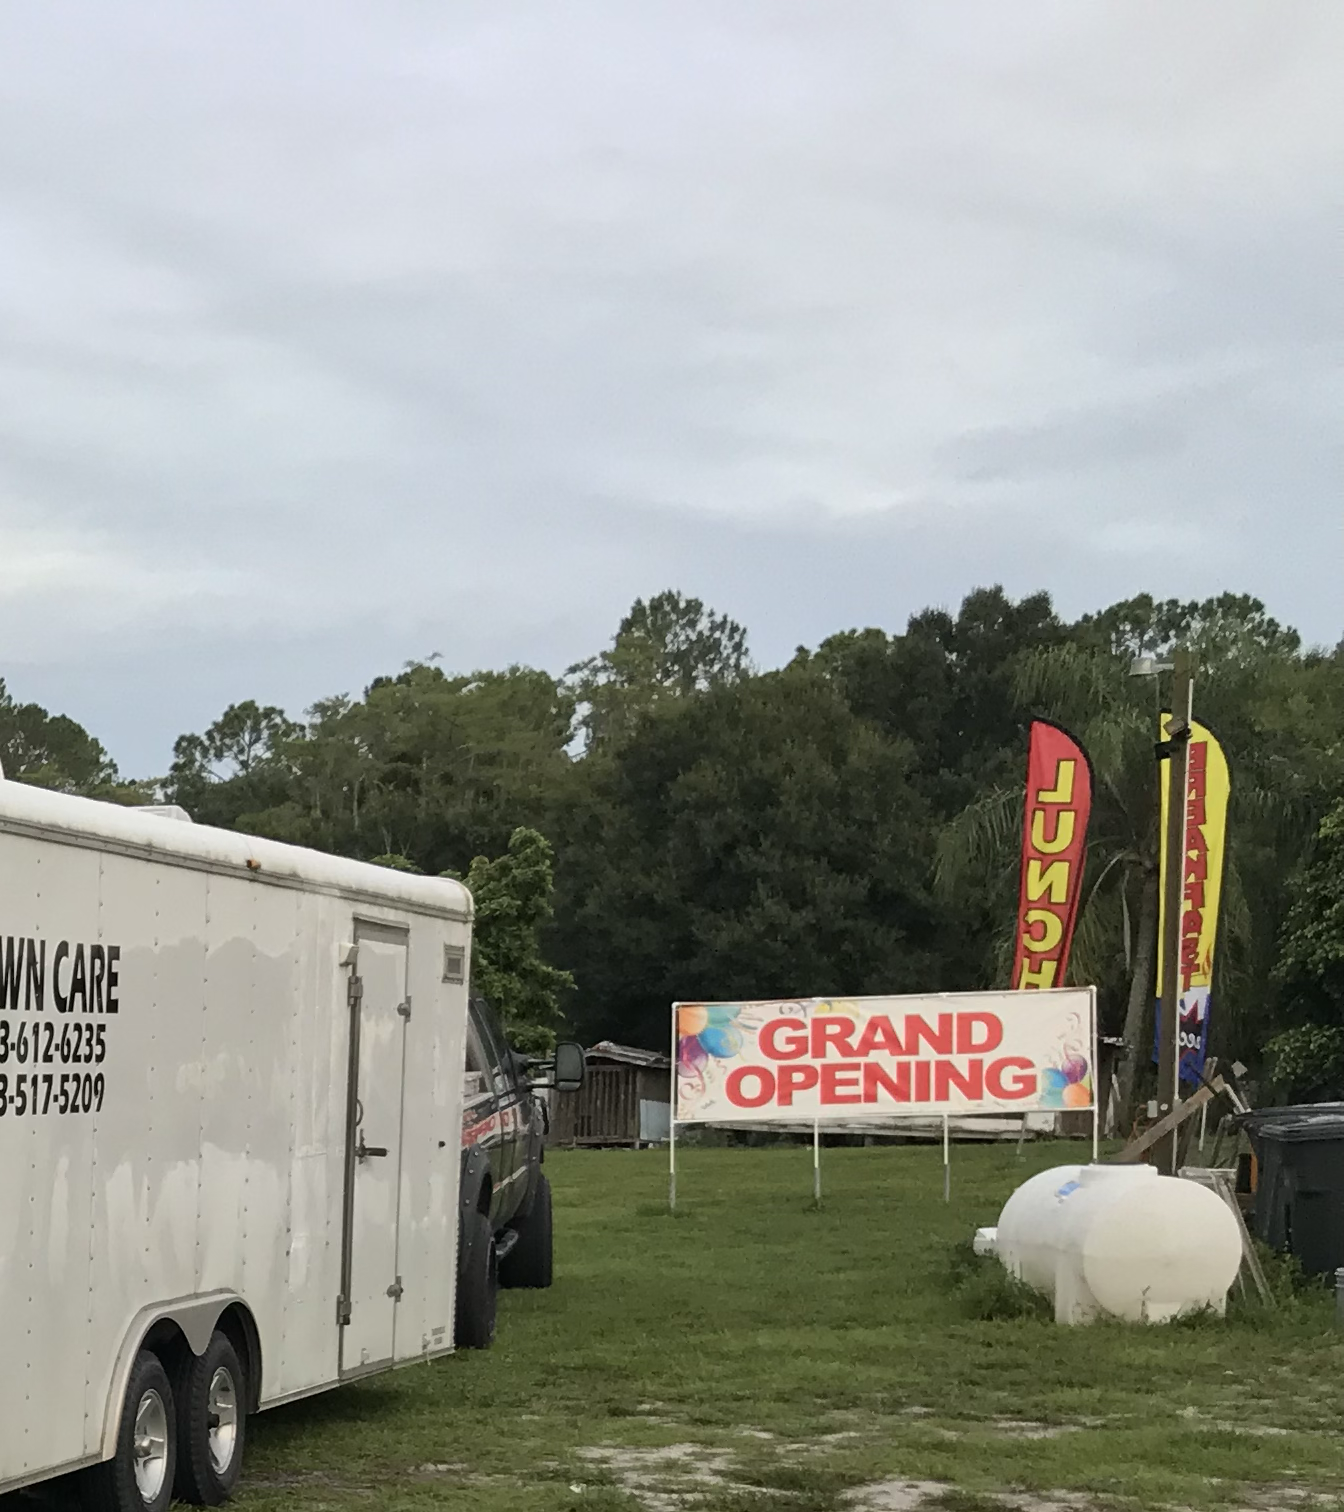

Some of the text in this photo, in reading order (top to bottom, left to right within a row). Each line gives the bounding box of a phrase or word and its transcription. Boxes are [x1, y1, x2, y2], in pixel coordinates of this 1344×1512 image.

[53, 940, 120, 1014] CARE
[758, 1011, 1004, 1061] GRAND
[725, 1056, 1037, 1108] OPENING
